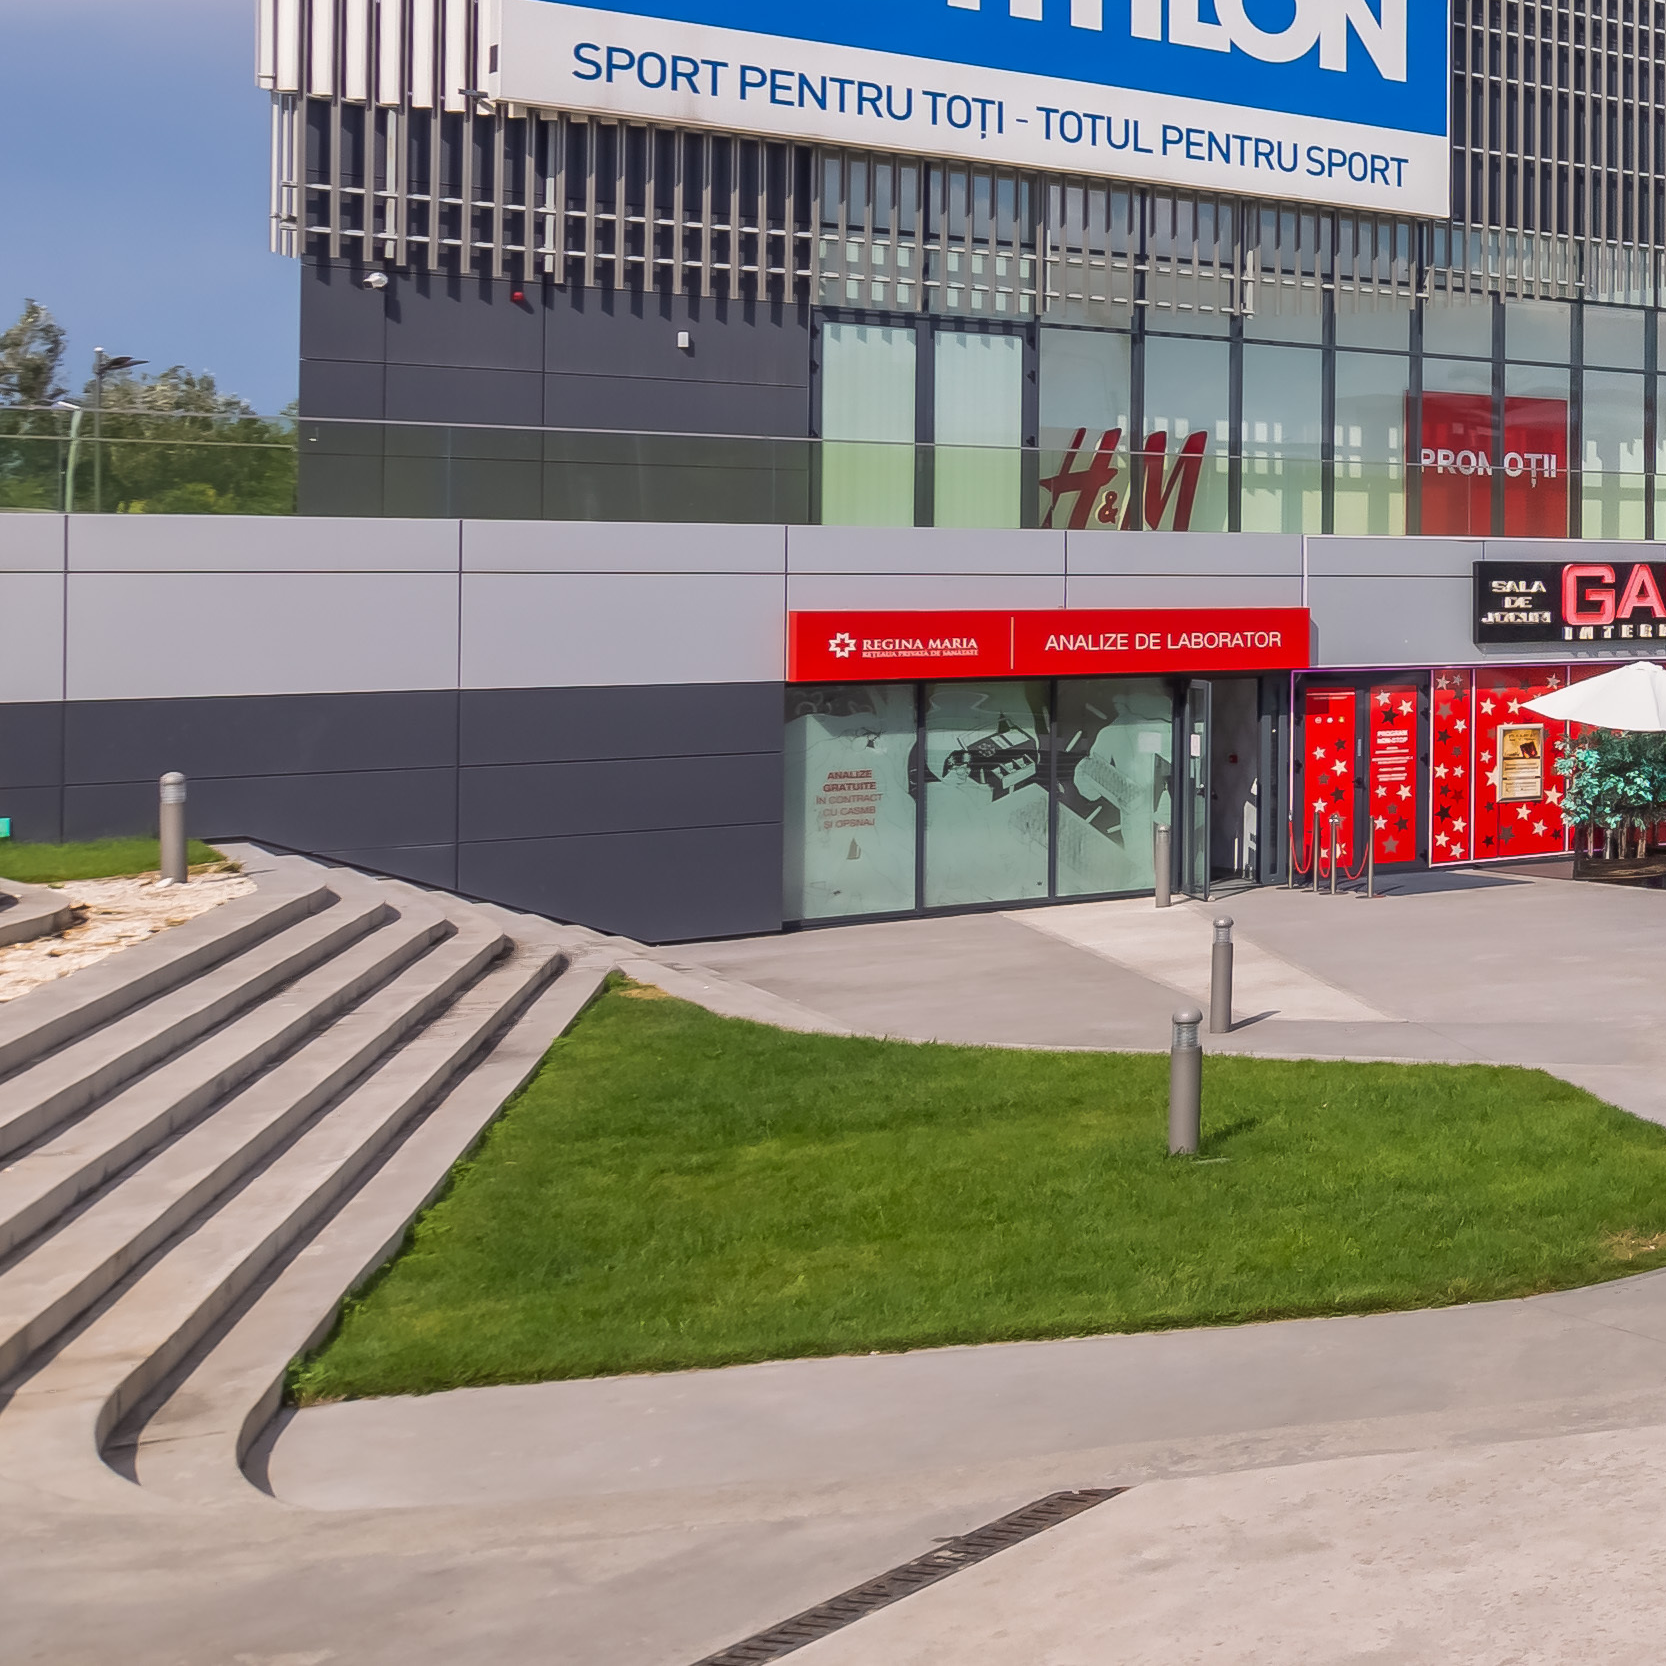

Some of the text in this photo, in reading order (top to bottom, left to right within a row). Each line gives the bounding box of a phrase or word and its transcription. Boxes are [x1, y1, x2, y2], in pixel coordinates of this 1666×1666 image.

[572, 42, 729, 97] SPORT
[739, 64, 913, 121] PENTRU
[1036, 105, 1154, 154] TOTUL
[1162, 123, 1299, 173] PENTRU
[1306, 145, 1410, 187] SPORT
[1039, 427, 1208, 531] H&M
[1491, 580, 1547, 593] SALA
[1504, 596, 1533, 608] DE
[862, 638, 978, 650] REGINA MARIA
[1044, 631, 1282, 651] ANALIZE DE LABORATOR
[827, 769, 873, 780] ANALIZE
[823, 781, 876, 792] GRATUITE
[829, 793, 883, 804] CONTRACT
